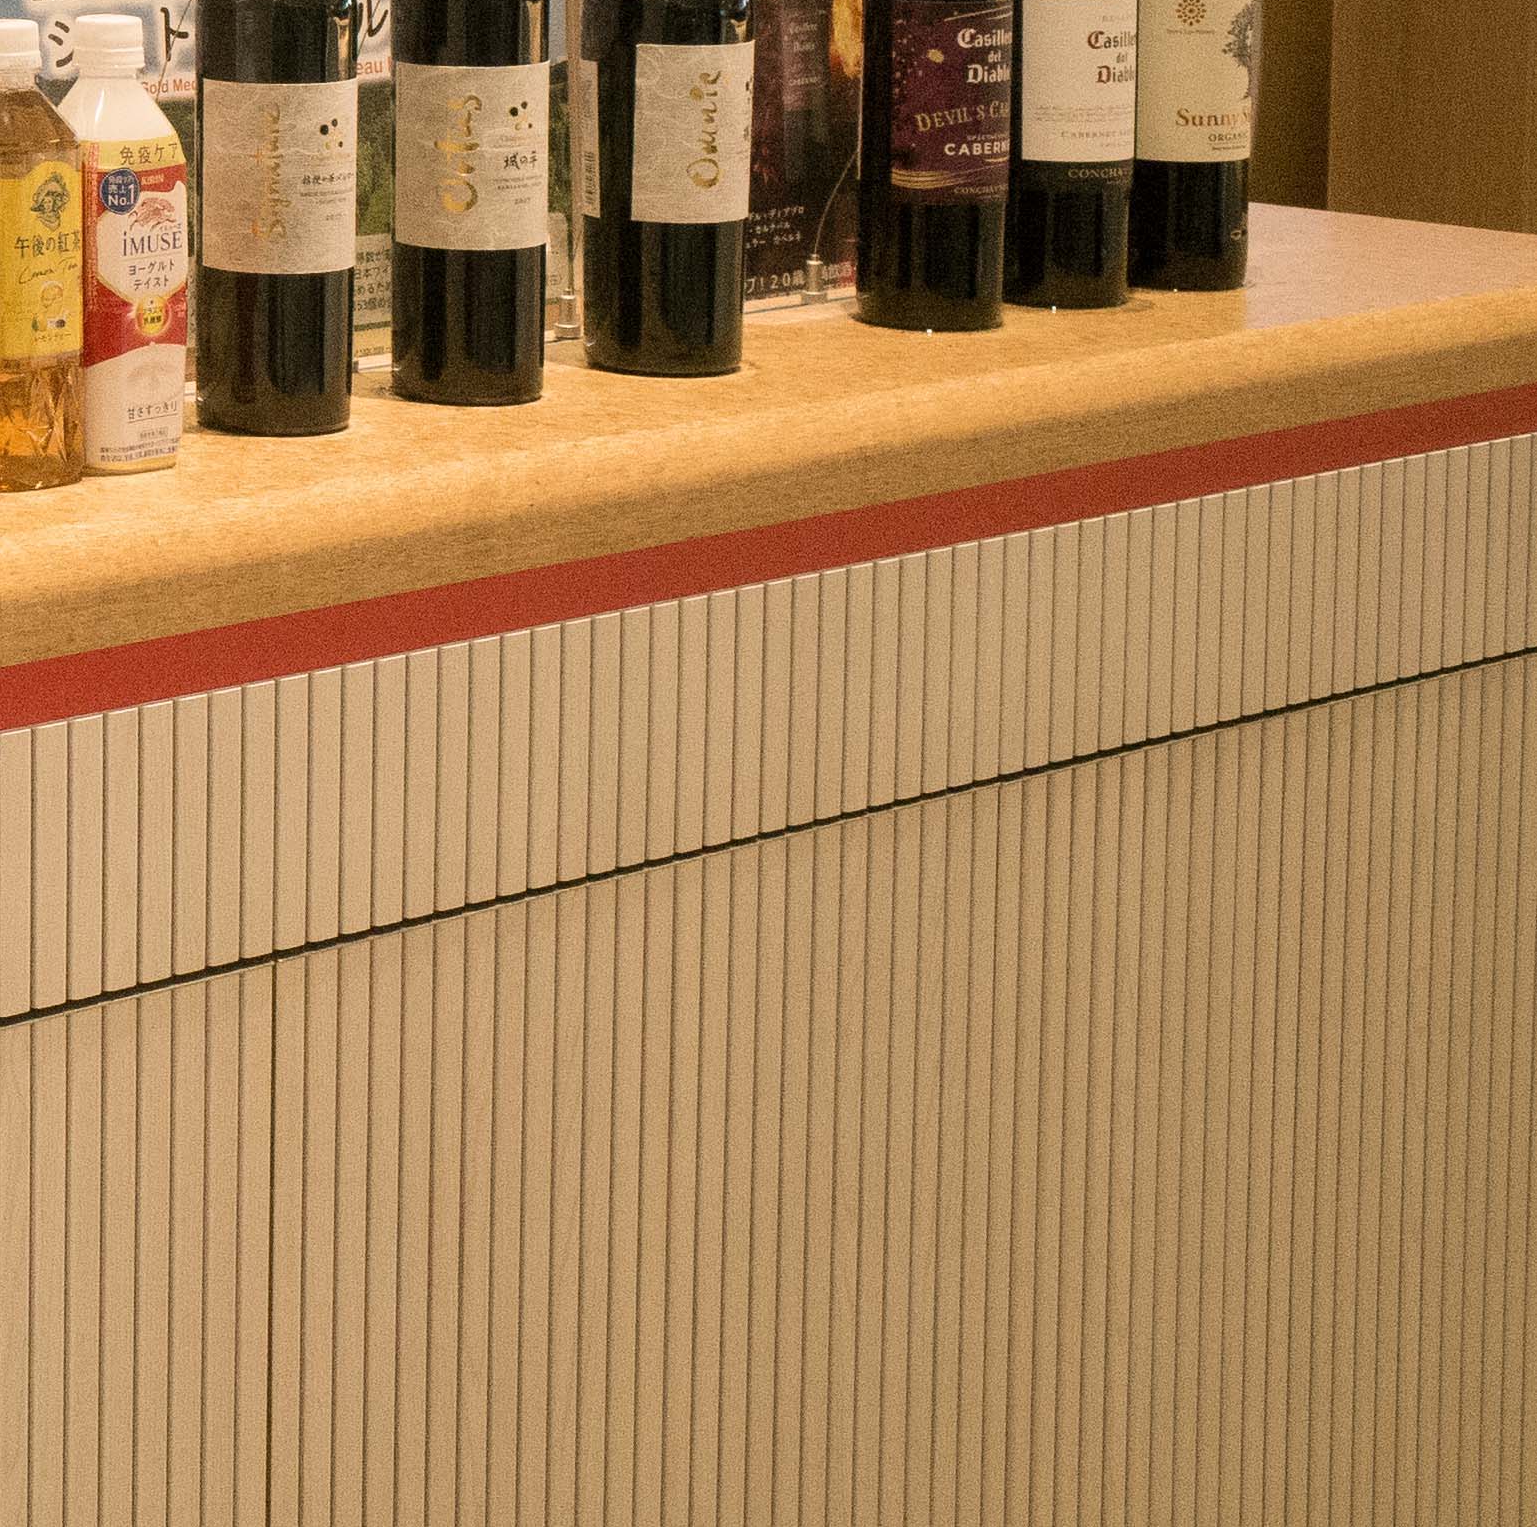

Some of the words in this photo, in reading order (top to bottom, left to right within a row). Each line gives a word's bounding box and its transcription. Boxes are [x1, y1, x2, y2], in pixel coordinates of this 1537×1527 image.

[915, 107, 986, 134] DEVIL'S
[119, 142, 179, 166] 免疫ケア
[107, 184, 127, 195] 売上
[121, 230, 184, 257] iMUSE
[128, 258, 176, 276] ヨーグルト
[133, 276, 170, 291] テイスト
